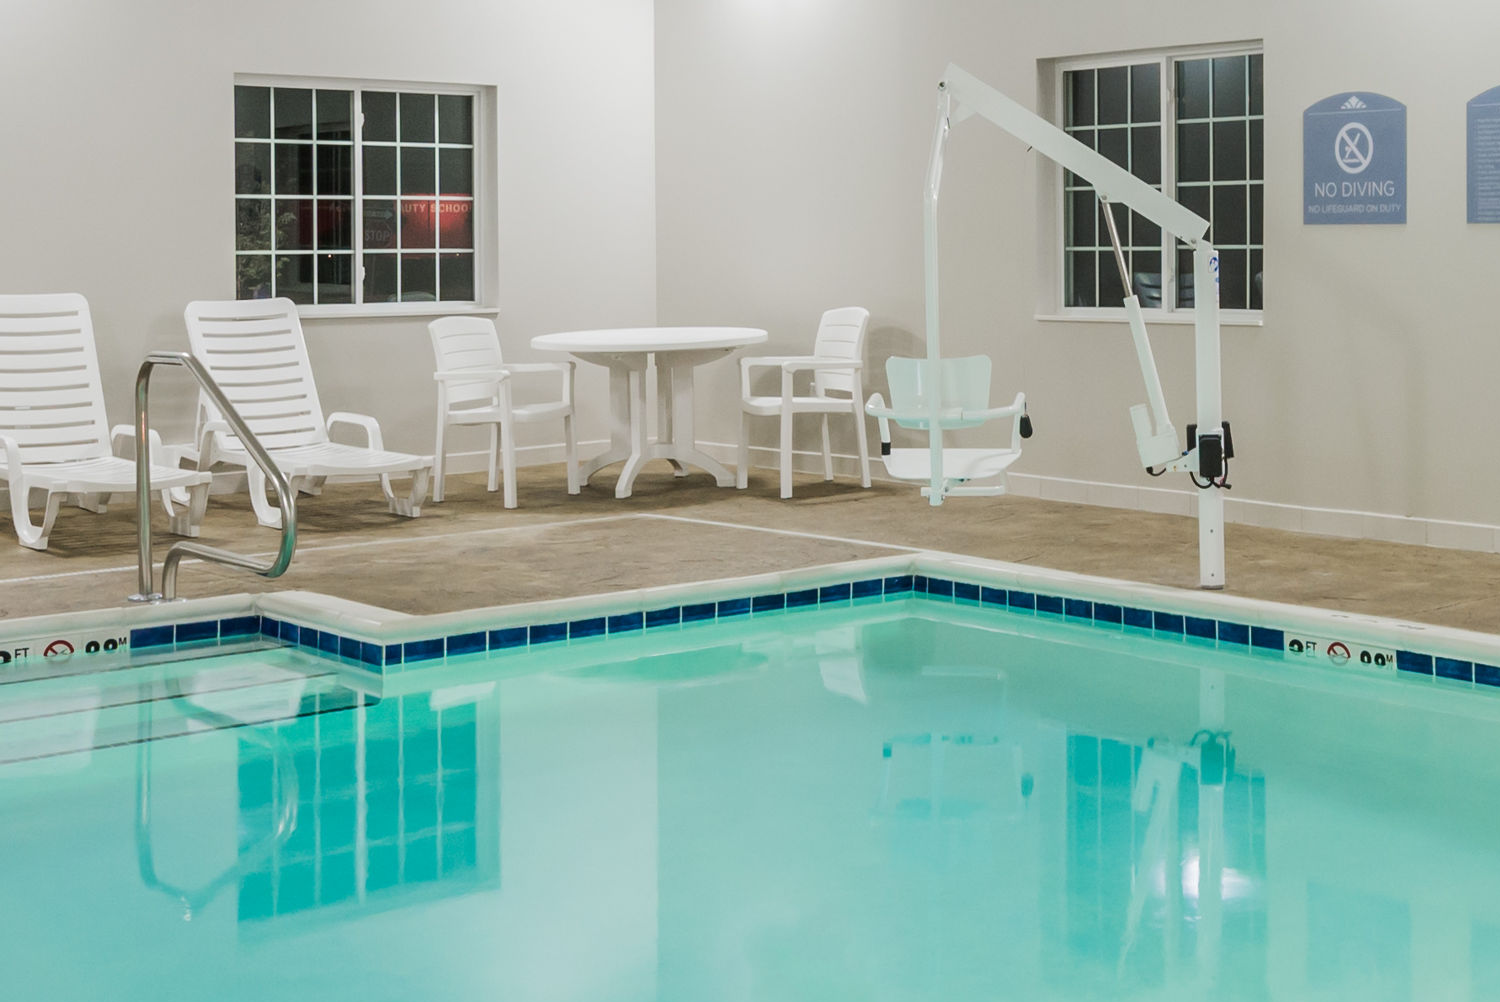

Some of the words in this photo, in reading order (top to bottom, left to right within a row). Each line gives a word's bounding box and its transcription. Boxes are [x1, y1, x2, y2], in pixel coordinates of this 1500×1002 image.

[1314, 181, 1337, 198] NO
[1341, 180, 1395, 198] DIVING
[1308, 204, 1320, 213] NO
[1321, 203, 1364, 214] LIFEGUARD
[1366, 203, 1378, 213] ON
[1381, 203, 1401, 213] DUTY
[365, 230, 390, 242] STOP
